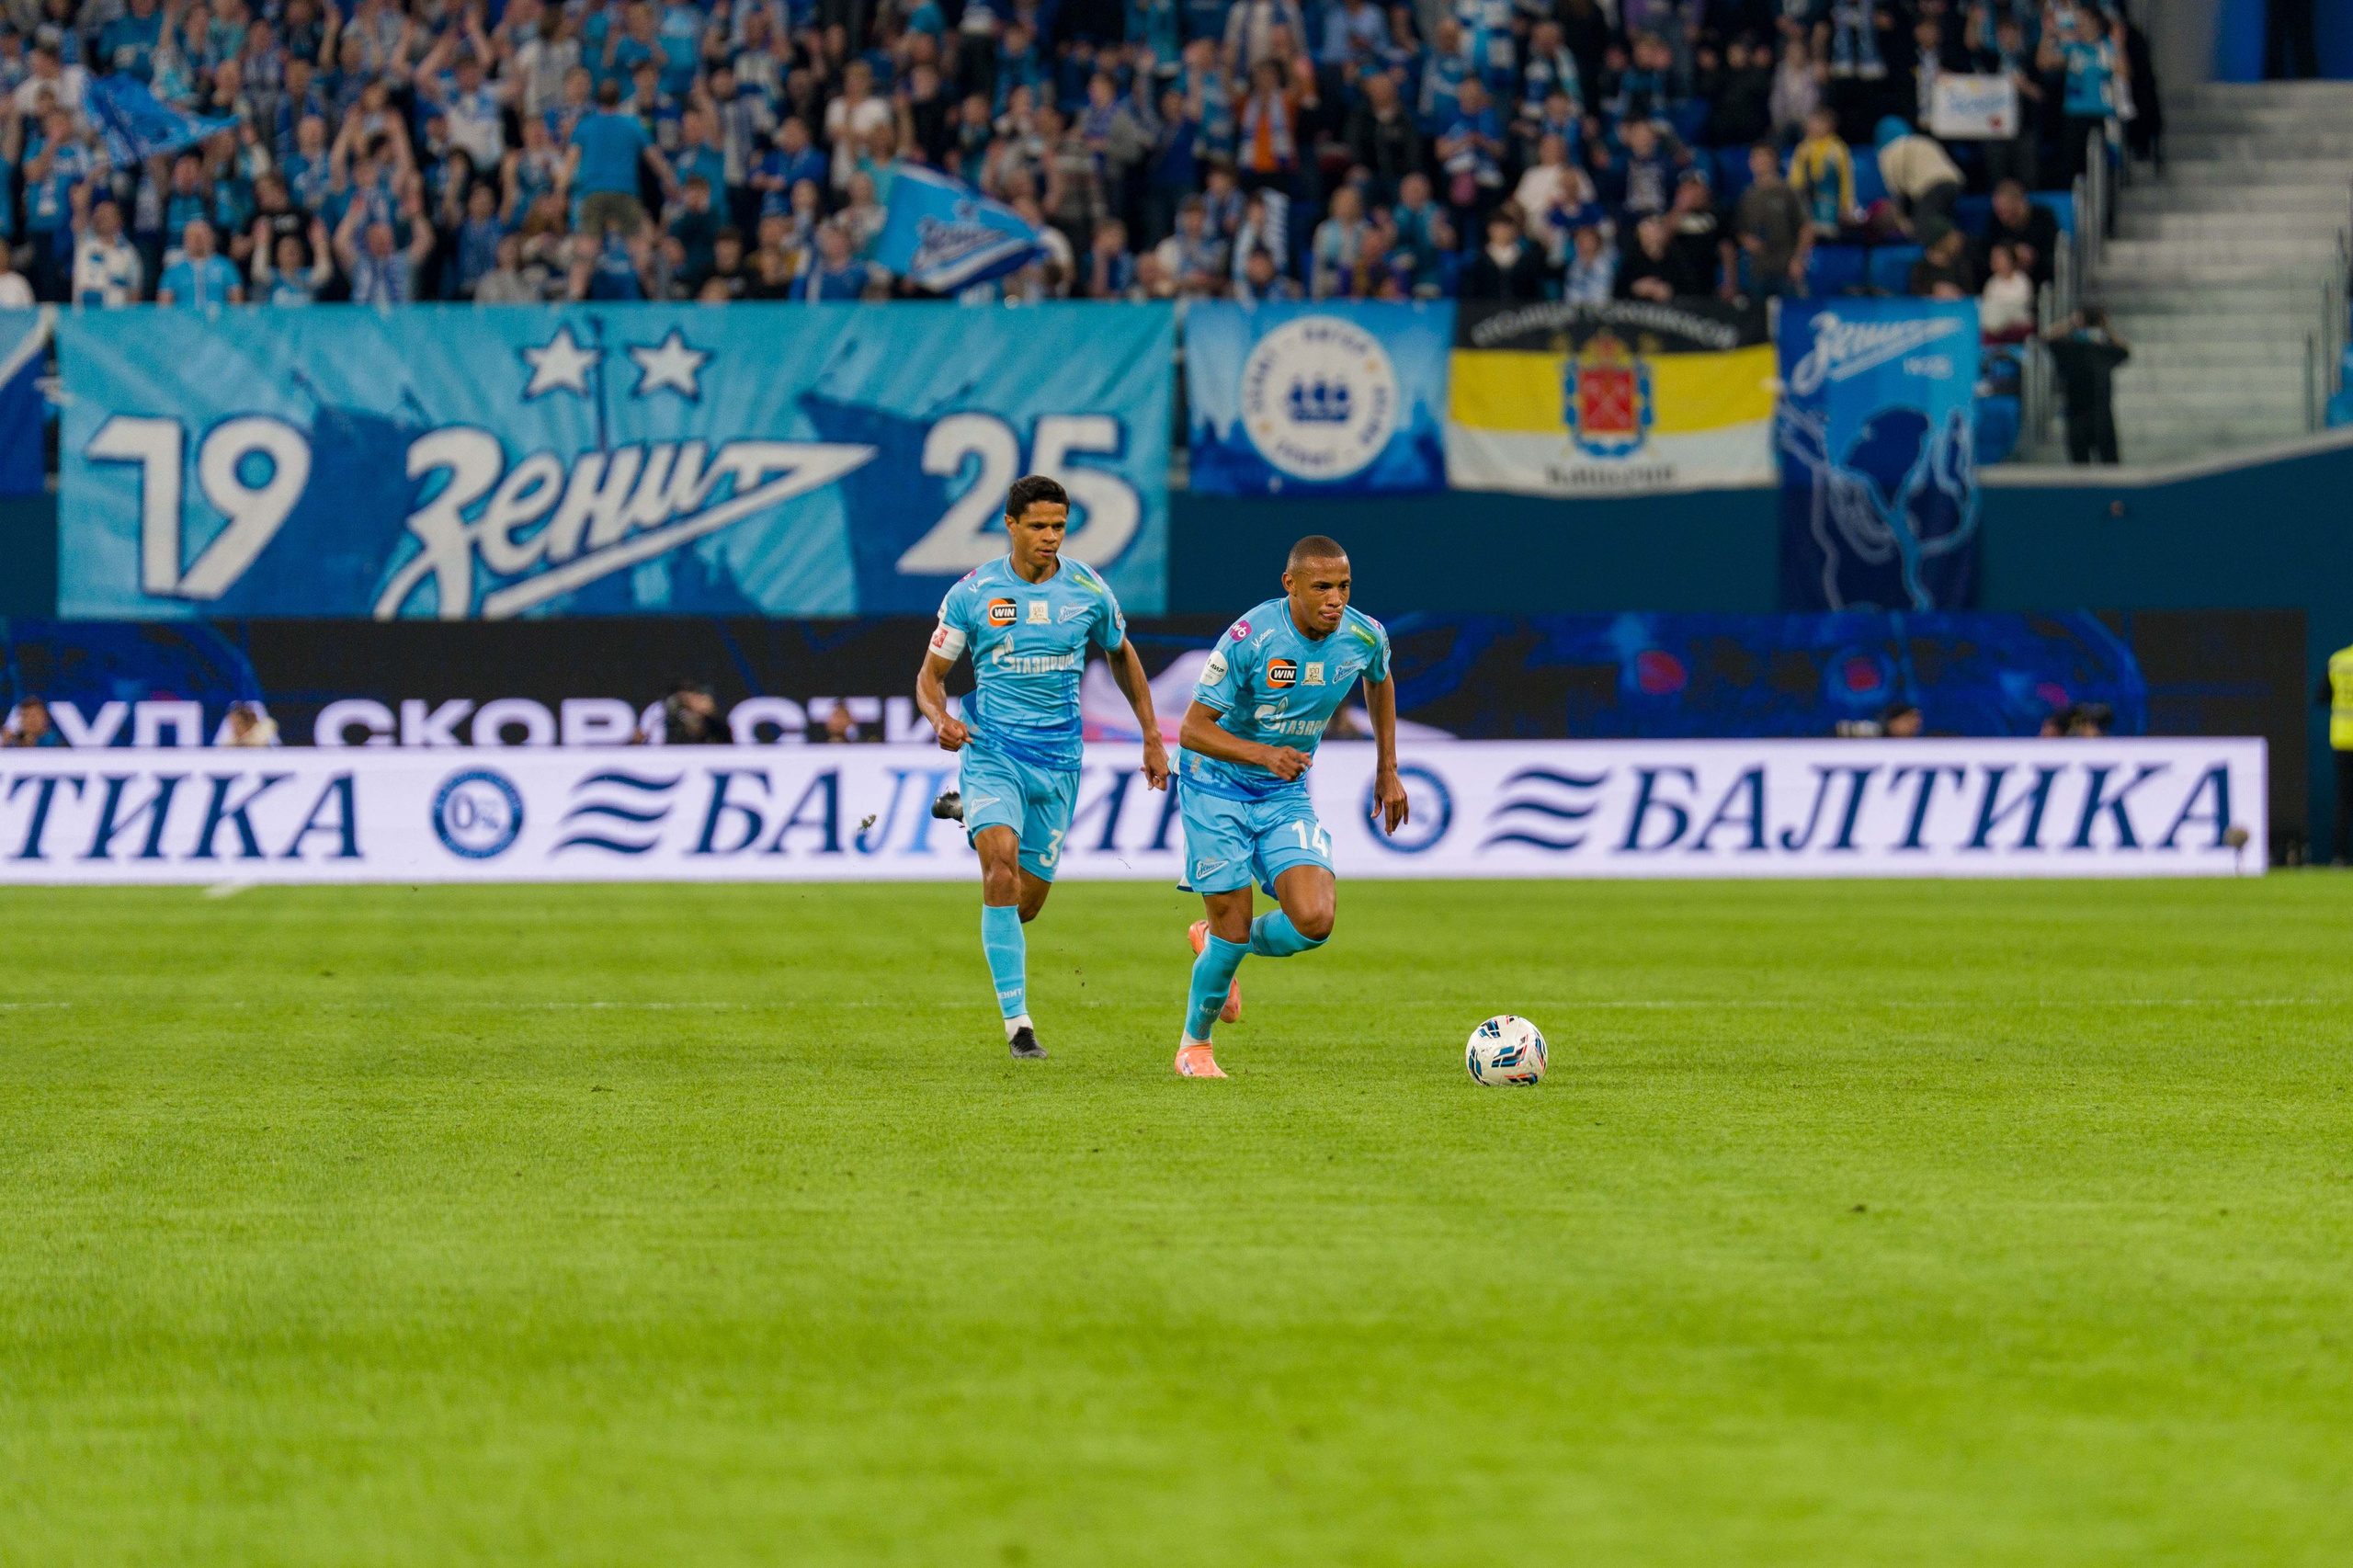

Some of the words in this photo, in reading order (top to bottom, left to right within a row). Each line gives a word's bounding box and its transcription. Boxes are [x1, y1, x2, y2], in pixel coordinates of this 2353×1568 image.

[86, 414, 313, 600] 19
[373, 425, 878, 621] Зенит
[895, 412, 1141, 576] 25
[995, 608, 1016, 618] WIN
[1016, 653, 1074, 674] ГАЗПРОМ
[1274, 669, 1295, 679] WIN
[0, 770, 365, 859] ТИКА
[1608, 760, 2233, 851] БАЛТИКА
[1040, 830, 1063, 868] 3
[1291, 820, 1327, 858] 14
